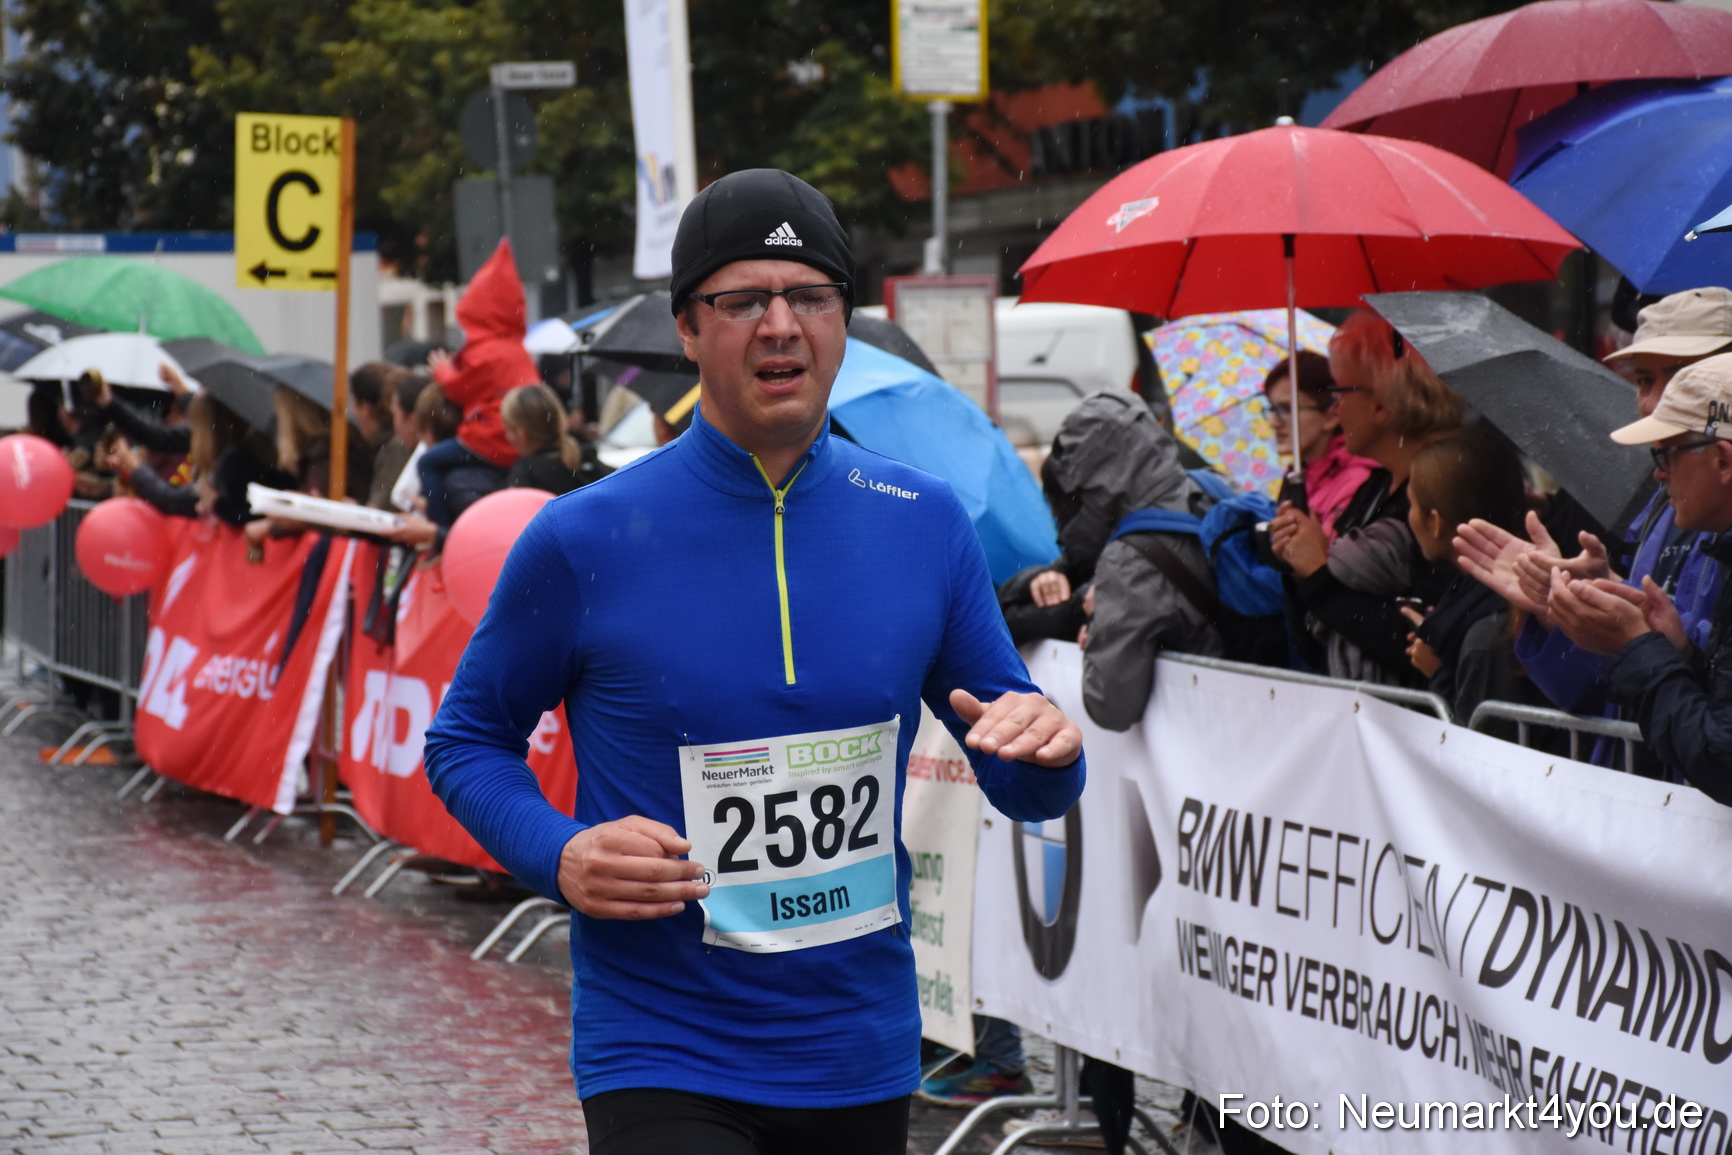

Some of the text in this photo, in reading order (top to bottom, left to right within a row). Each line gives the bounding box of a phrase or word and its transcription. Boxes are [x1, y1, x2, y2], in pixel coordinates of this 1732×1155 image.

[251, 123, 341, 157] Block
[266, 169, 321, 253] C
[764, 236, 803, 247] adidas
[868, 479, 920, 500] Löffler
[786, 730, 883, 769] BOCK
[788, 754, 883, 779] inspired by smart concepts
[701, 764, 775, 781] NeuerMarkt
[713, 774, 880, 874] 2582
[1178, 797, 1272, 908] BMW
[770, 885, 851, 922] Issam
[1176, 917, 1275, 1007] WENIGER
[1284, 951, 1468, 1072] VERBRAUCH.
